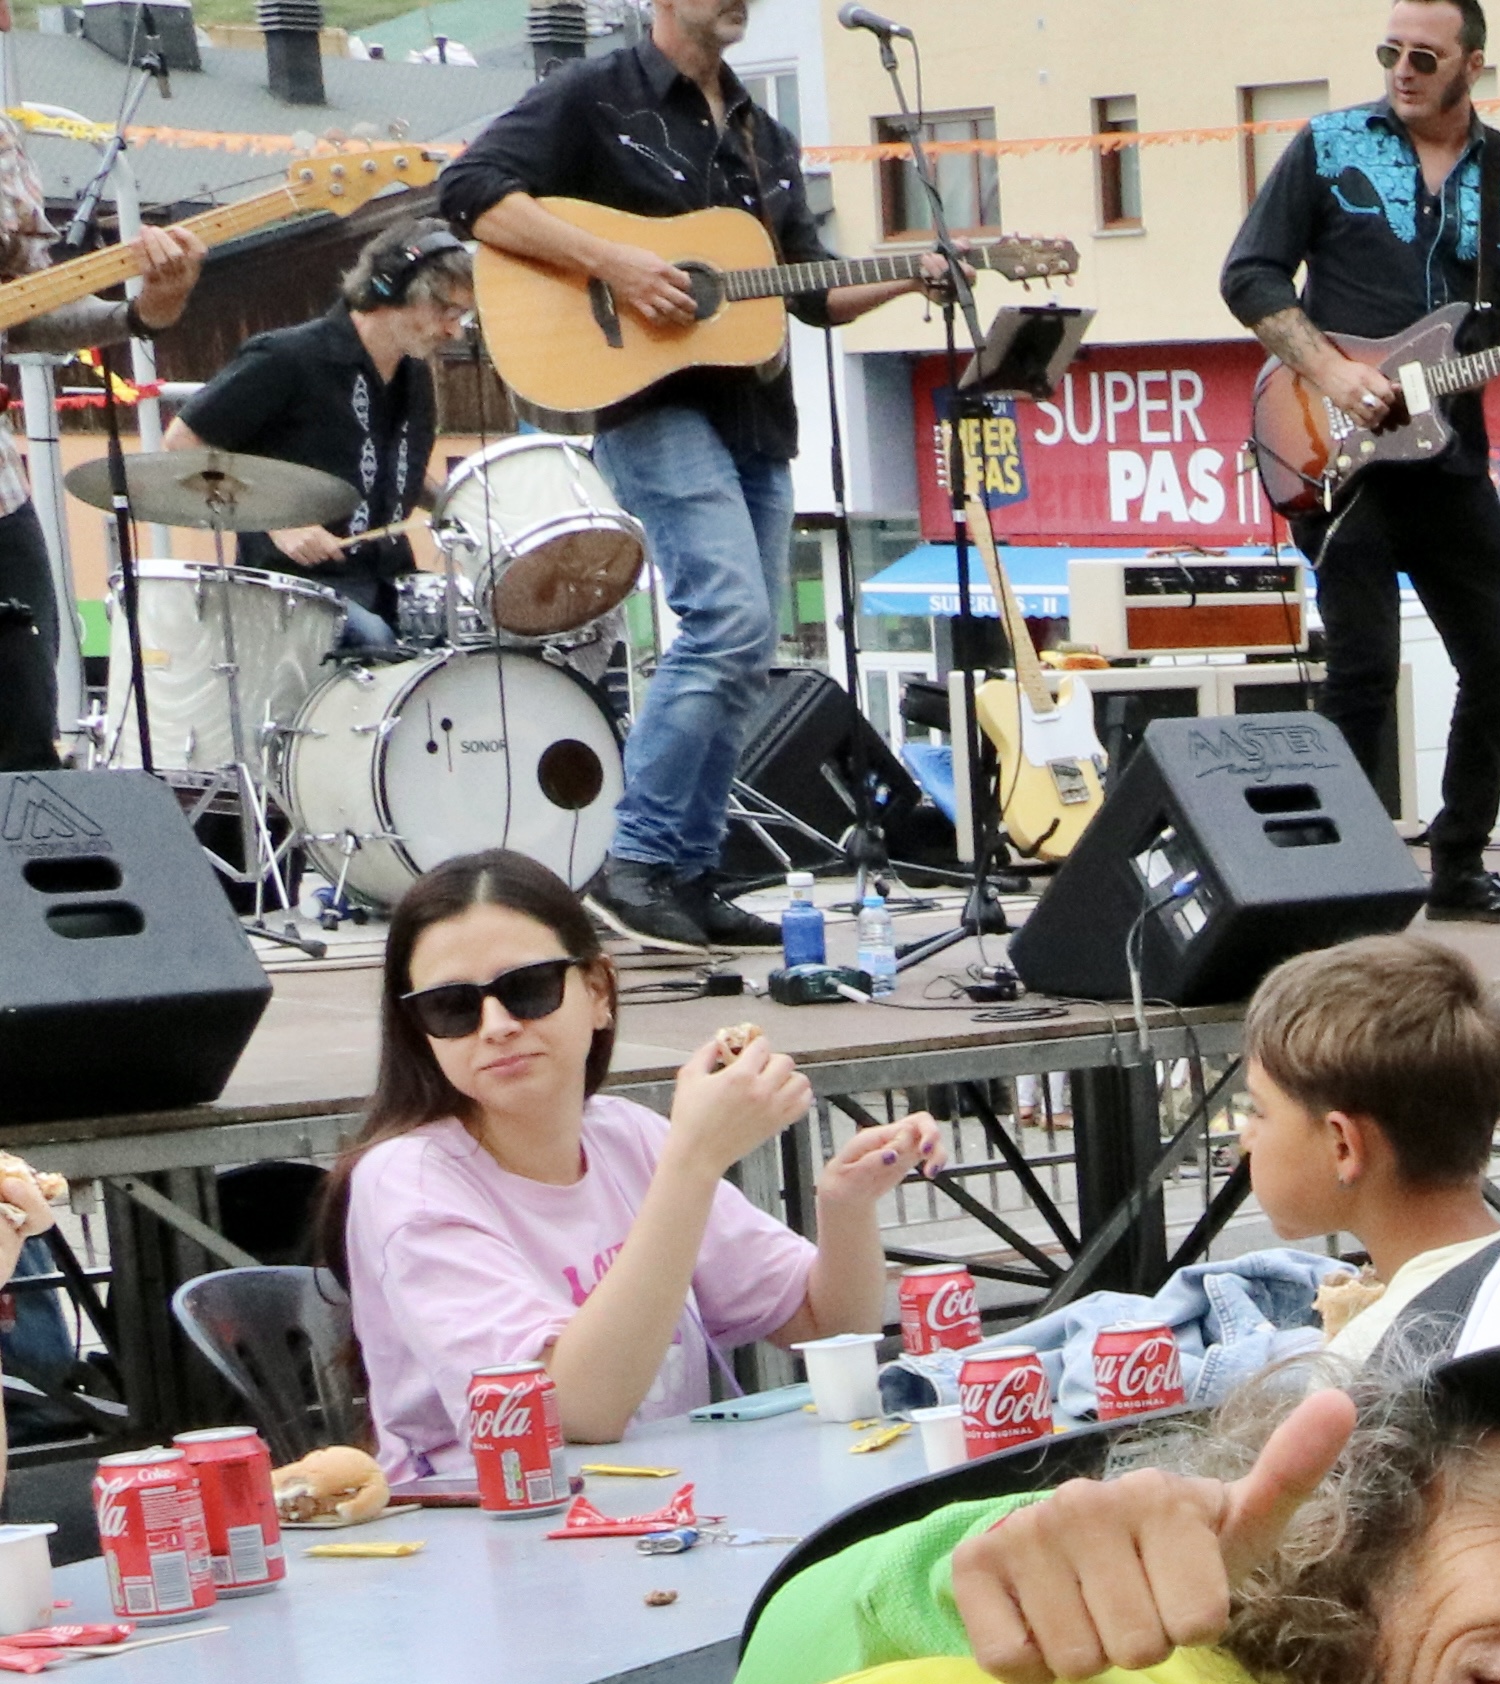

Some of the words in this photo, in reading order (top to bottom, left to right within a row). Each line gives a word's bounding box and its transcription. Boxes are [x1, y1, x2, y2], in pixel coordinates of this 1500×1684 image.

[1034, 369, 1207, 446] SUPER
[1108, 449, 1226, 524] PAS
[1115, 1396, 1165, 1410] ORIGINAL
[984, 1426, 1035, 1441] ORIGINAL
[137, 1467, 177, 1483] Coke
